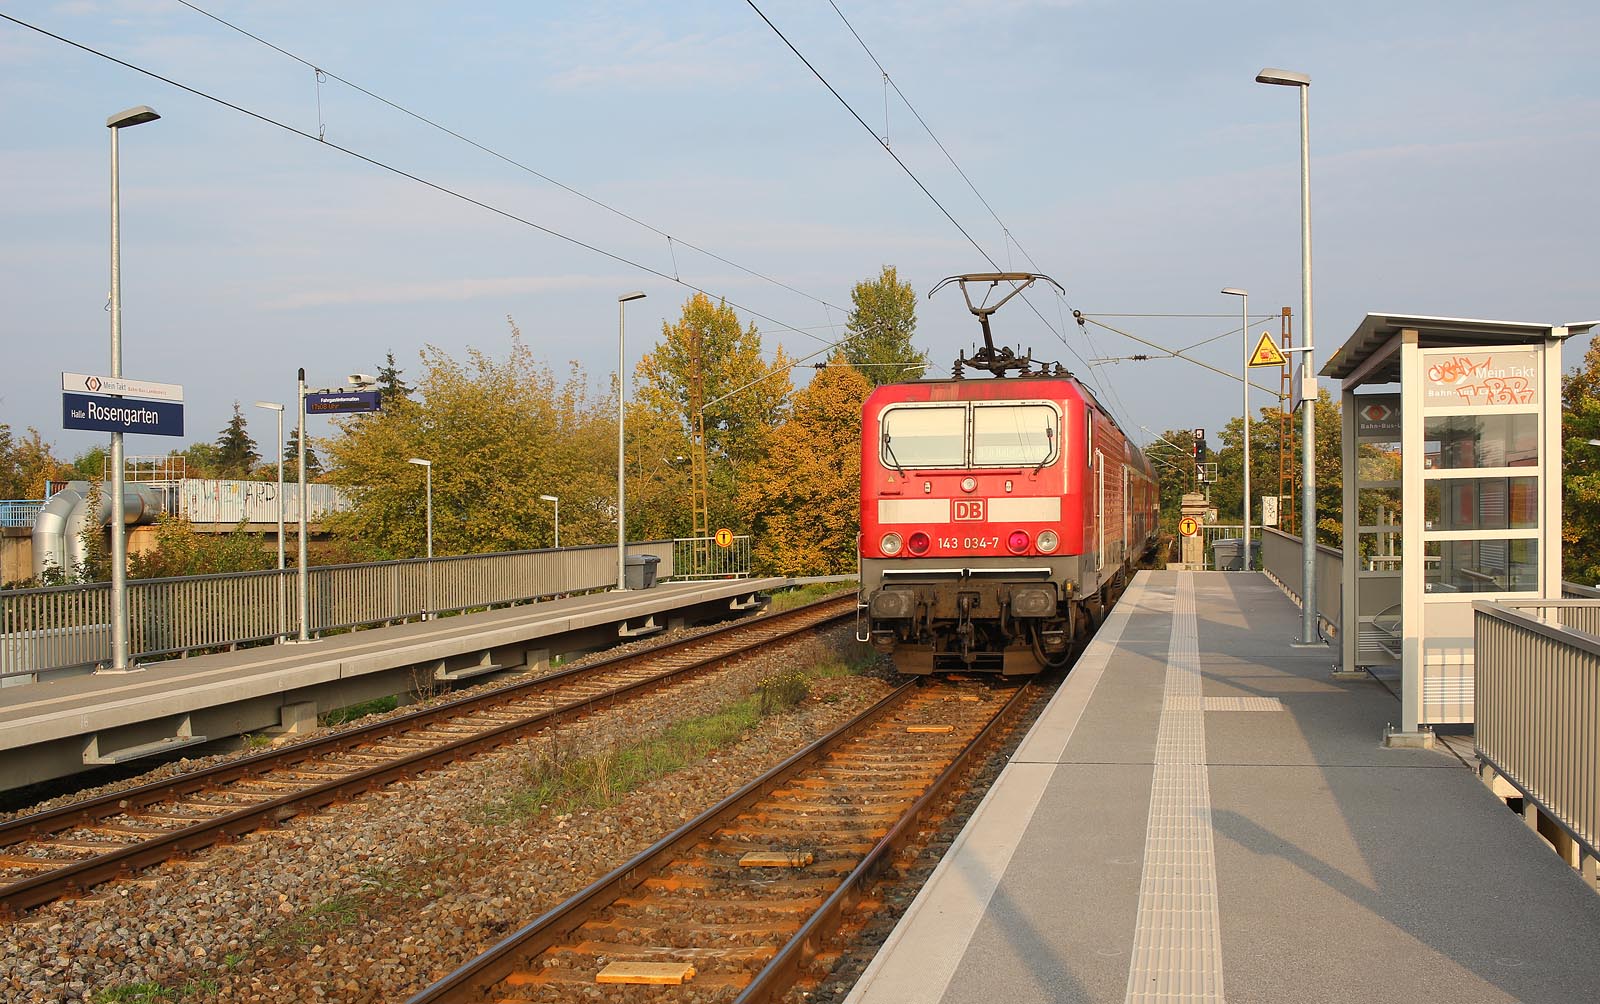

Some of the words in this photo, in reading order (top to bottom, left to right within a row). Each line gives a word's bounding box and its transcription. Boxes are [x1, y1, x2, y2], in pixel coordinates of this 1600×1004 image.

[1476, 367, 1505, 378] Mein
[1508, 366, 1535, 378] Takt
[71, 410, 86, 419] Halle
[88, 402, 158, 426] Rosengarten
[1196, 429, 1204, 439] 5
[956, 501, 982, 519] DB
[938, 537, 959, 549] 143
[964, 537, 999, 549] 034-7
